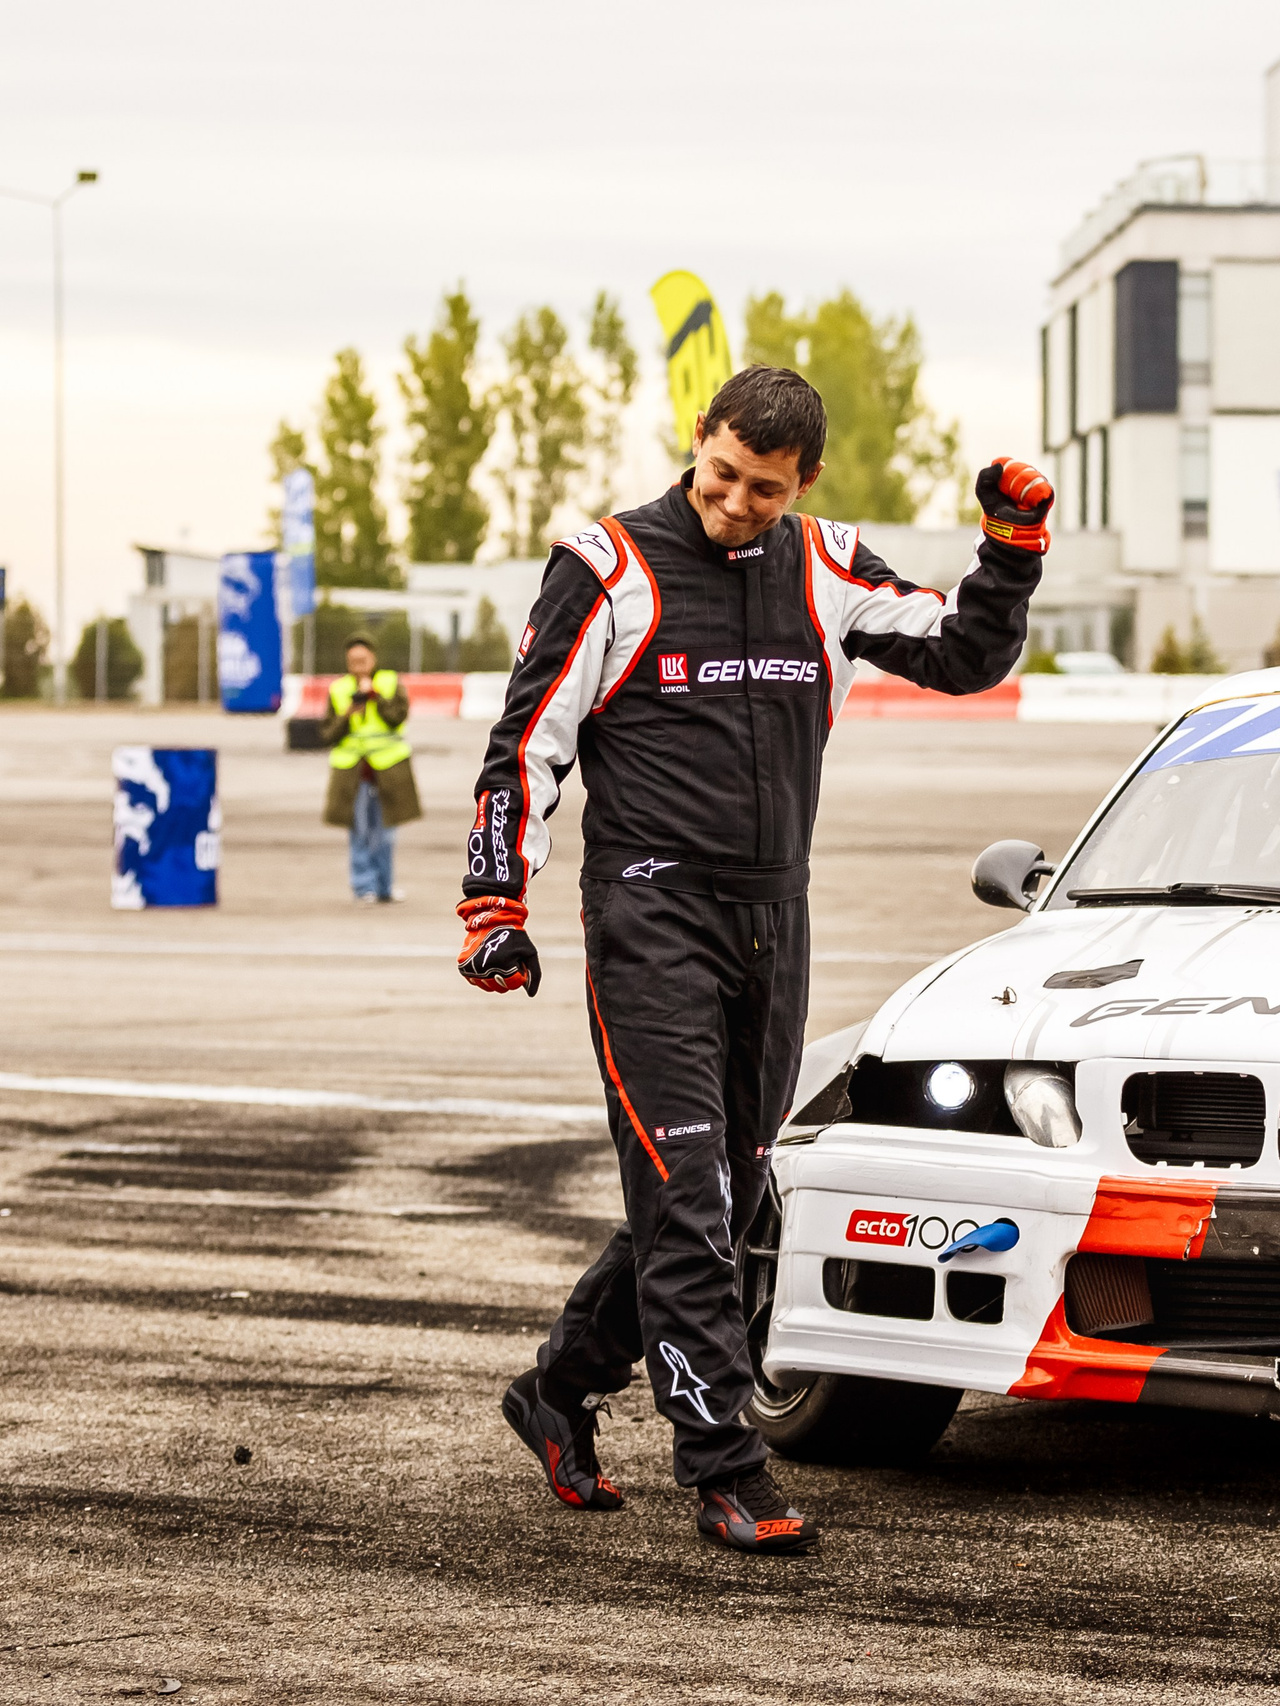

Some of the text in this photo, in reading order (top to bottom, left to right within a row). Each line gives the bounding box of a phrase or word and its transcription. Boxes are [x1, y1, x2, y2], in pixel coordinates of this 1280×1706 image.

[697, 658, 819, 683] GENESIS
[660, 685, 690, 693] LUKOIL
[668, 1123, 711, 1136] GENESIS
[755, 1520, 803, 1536] OMP
